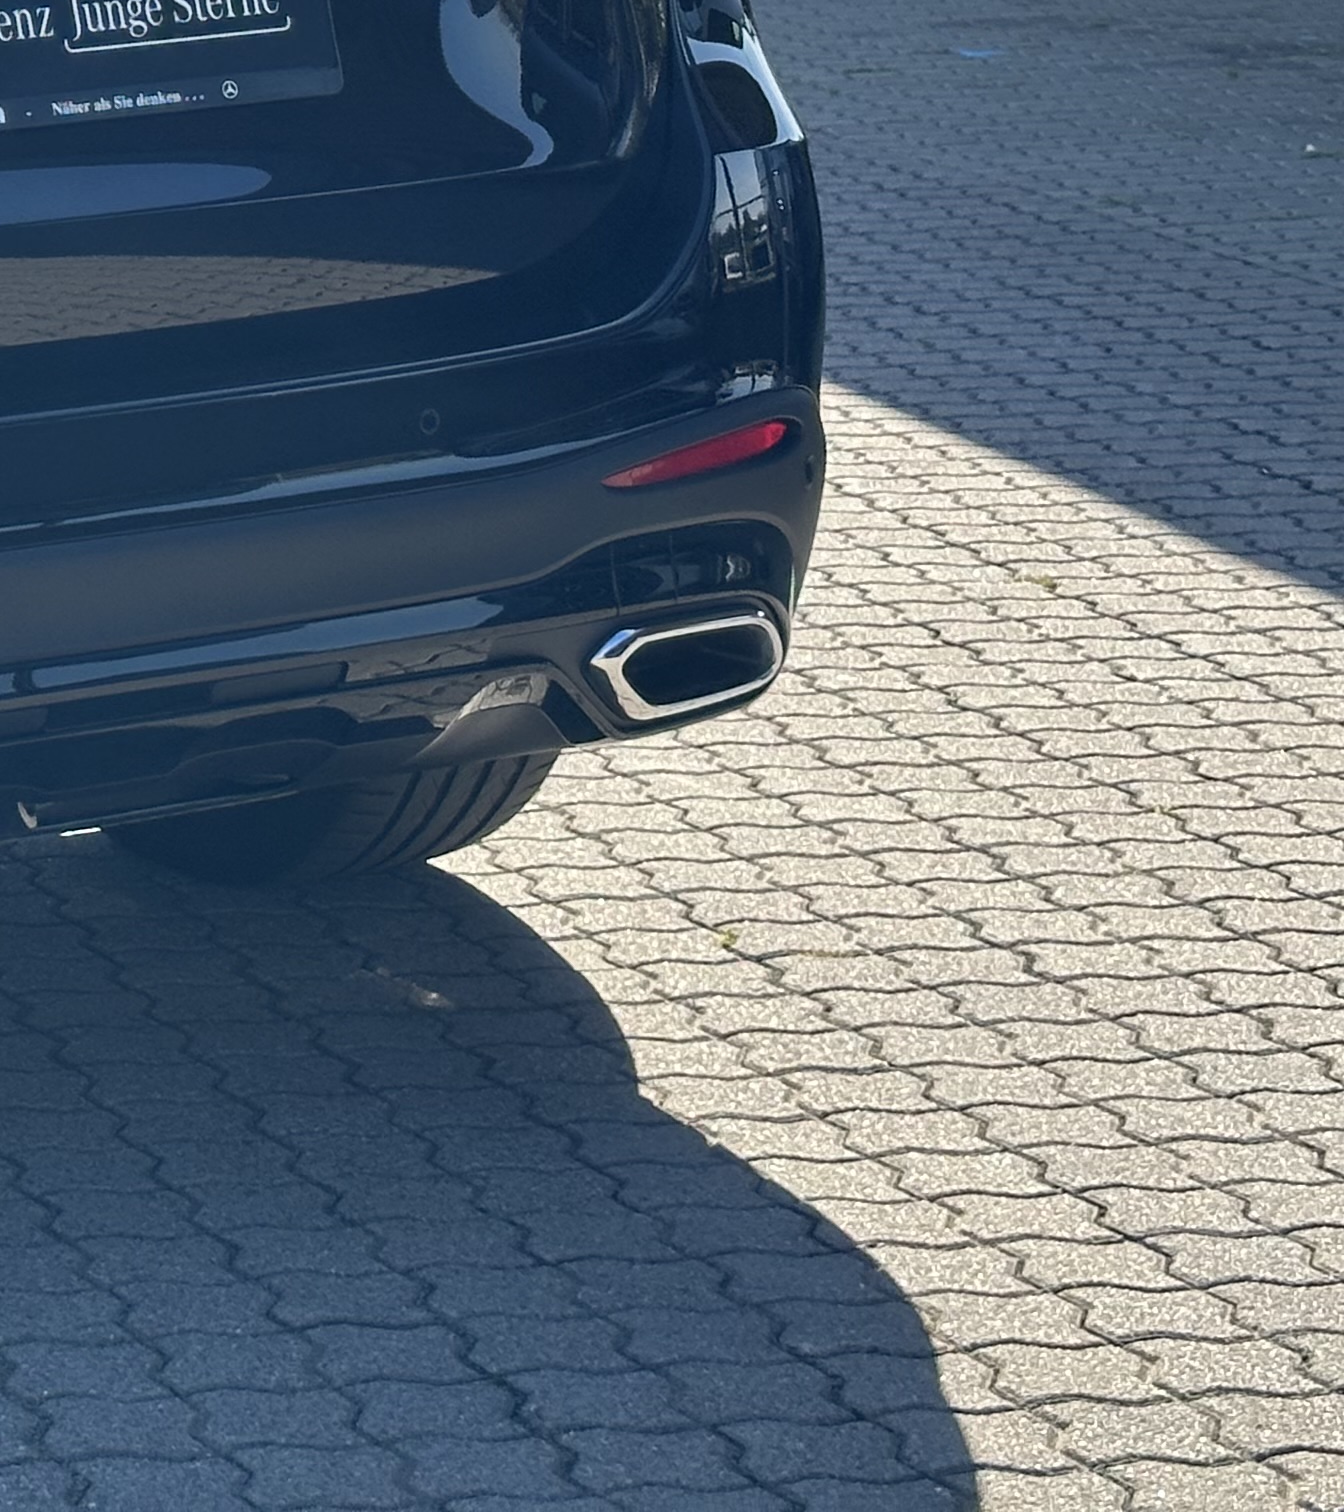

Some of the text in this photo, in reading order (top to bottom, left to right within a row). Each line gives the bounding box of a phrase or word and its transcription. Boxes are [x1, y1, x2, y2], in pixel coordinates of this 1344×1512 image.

[51, 100, 91, 116] Näher
[93, 96, 113, 112] als
[113, 94, 134, 110] Sie
[135, 90, 182, 107] denken
